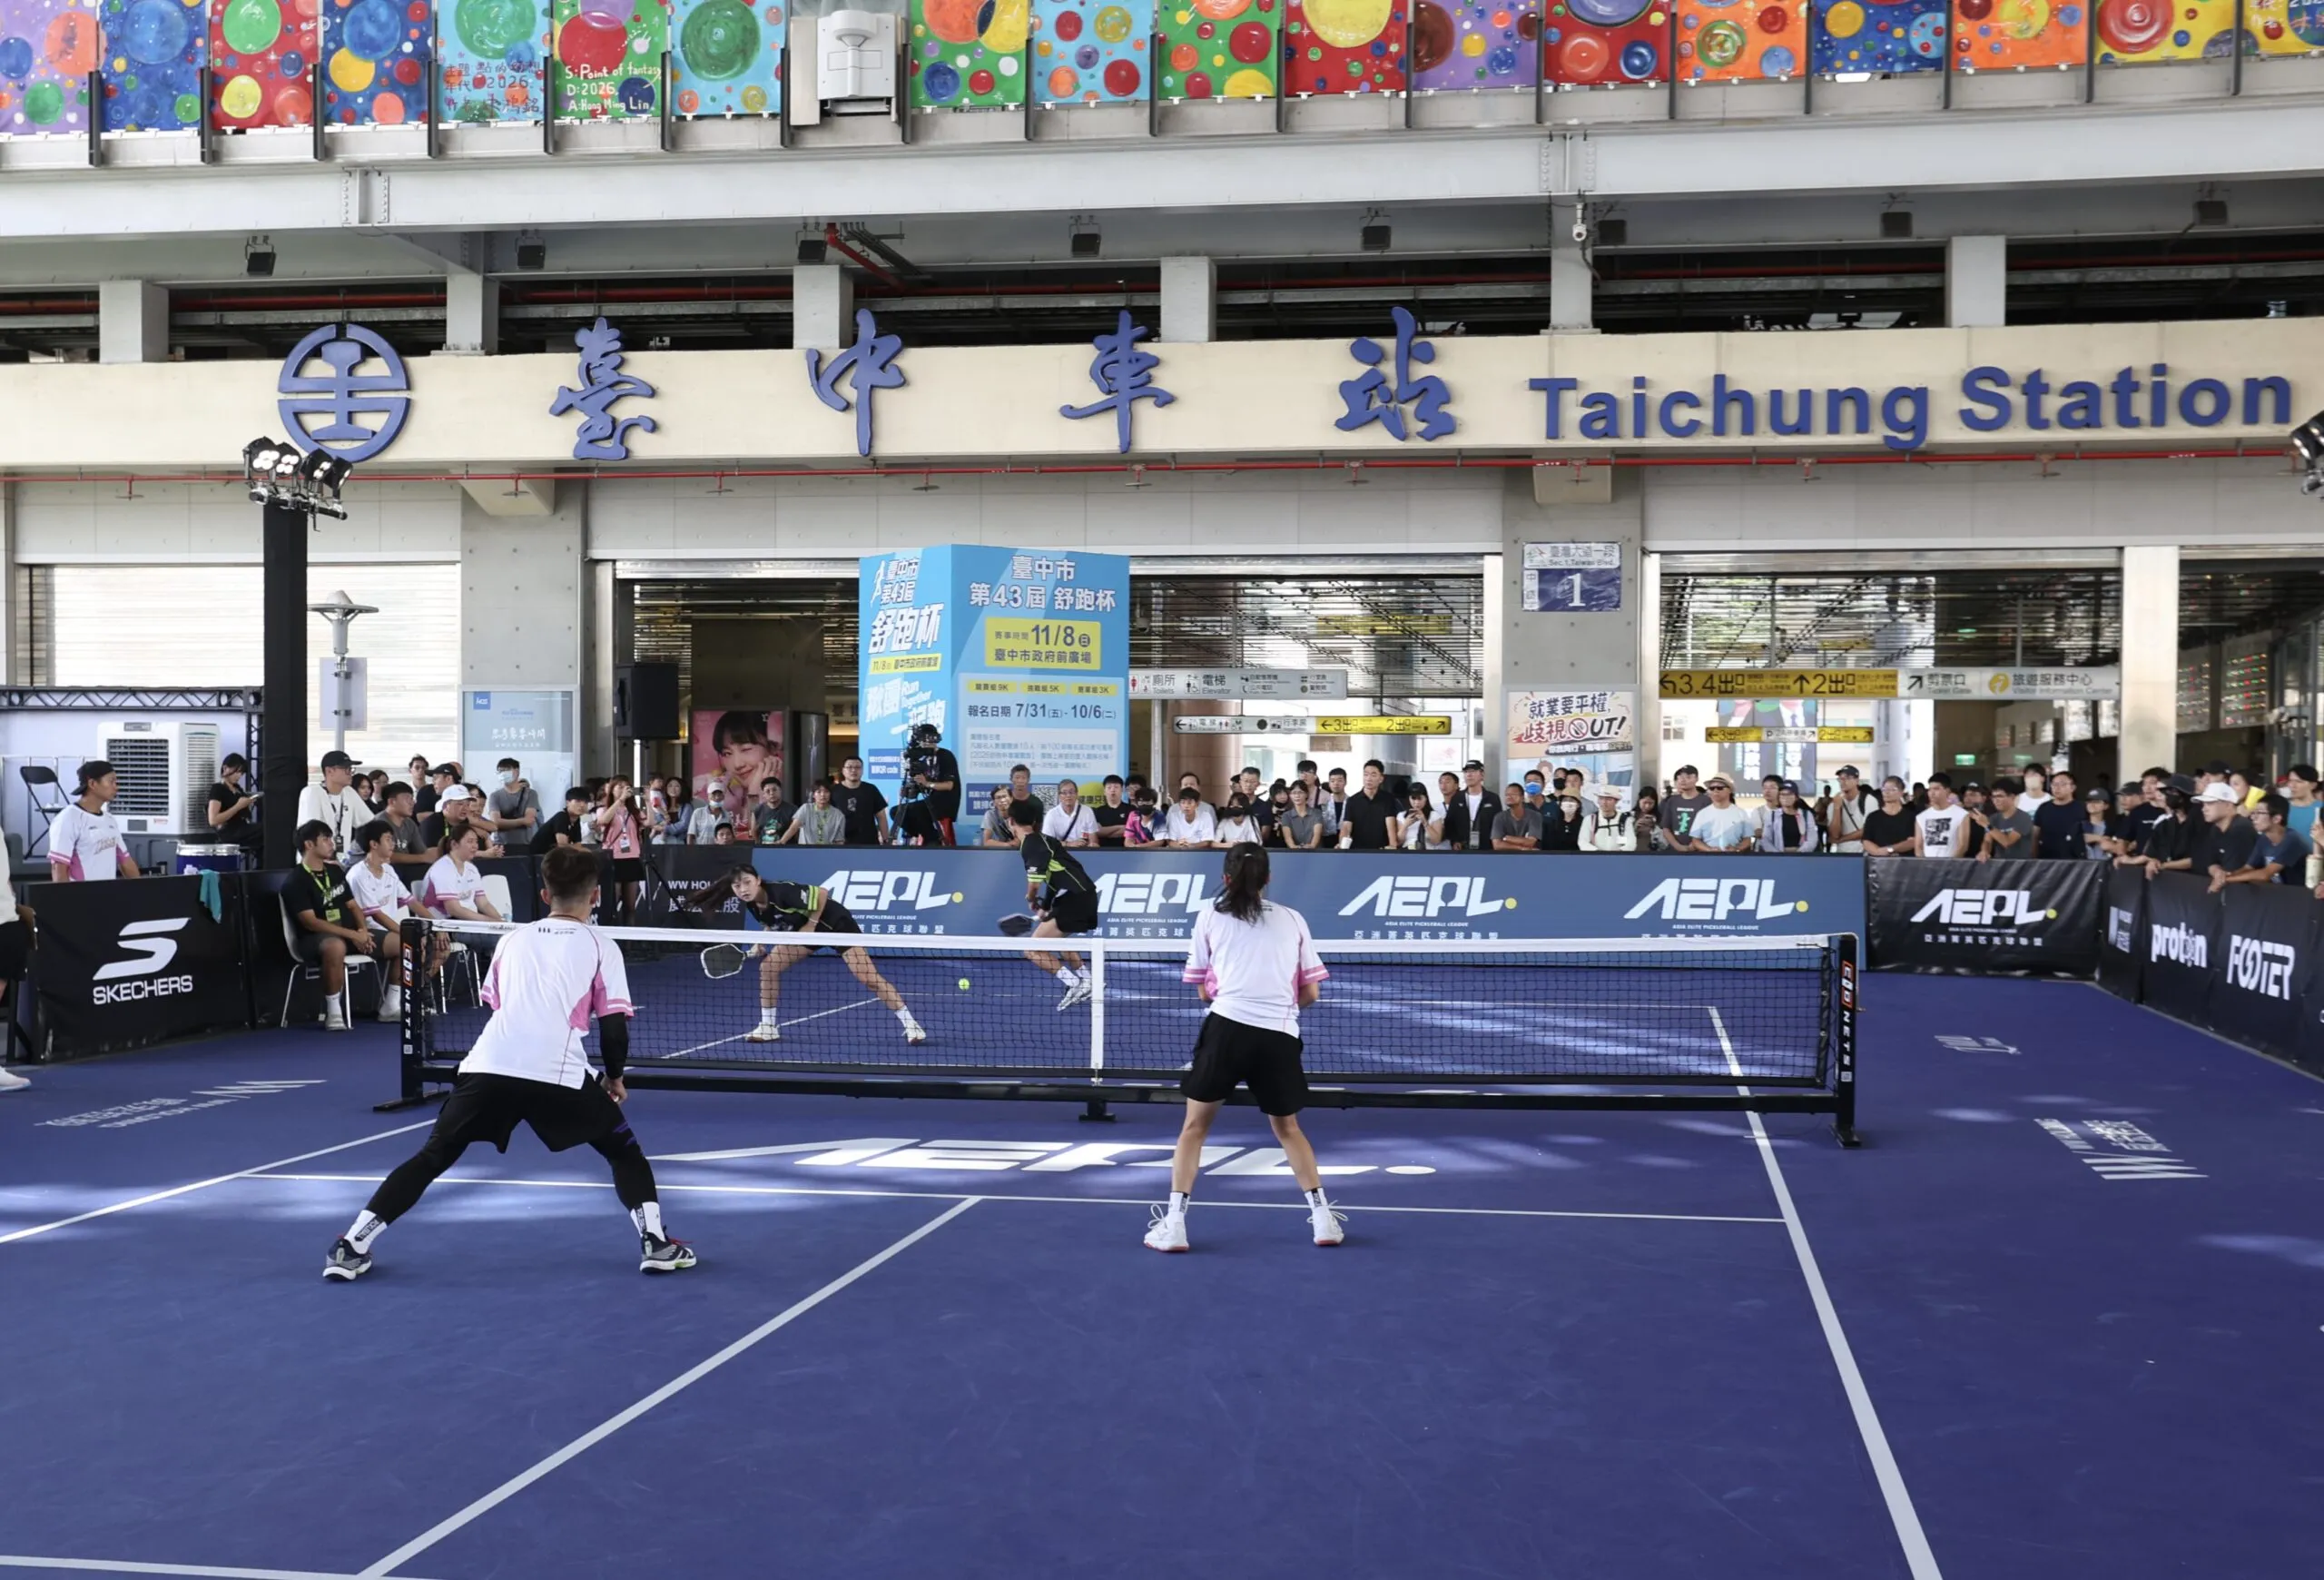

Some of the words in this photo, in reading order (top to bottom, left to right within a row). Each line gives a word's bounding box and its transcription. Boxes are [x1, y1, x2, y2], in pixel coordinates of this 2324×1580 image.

[612, 67, 625, 77] of
[1529, 373, 1929, 450] Taichung
[1958, 362, 2292, 433] Station
[1011, 555, 1077, 582] 臺中市
[970, 582, 1047, 609] 第43屆
[1054, 587, 1117, 612] 舒跑杯
[1567, 572, 1587, 607] 1
[868, 602, 945, 654] 舒跑杯
[1031, 624, 1075, 647] 11/8
[994, 647, 1092, 665] 臺中市政府前廣場
[1152, 674, 1176, 686] 廁所
[1203, 674, 1226, 686] 電梯
[1812, 673, 1856, 695] 2出口
[1926, 674, 1966, 686] 剪票口
[2013, 673, 2093, 686] 旅遊服務中心
[968, 705, 1011, 717] 報名日期
[1528, 692, 1611, 719] 就業要平權,
[1334, 718, 1358, 732] 3出口
[1386, 718, 1411, 732] 2出口
[1522, 719, 1566, 741] 歧視
[2227, 933, 2295, 1001] FOOTER
[93, 974, 193, 1005] SKECHERS
